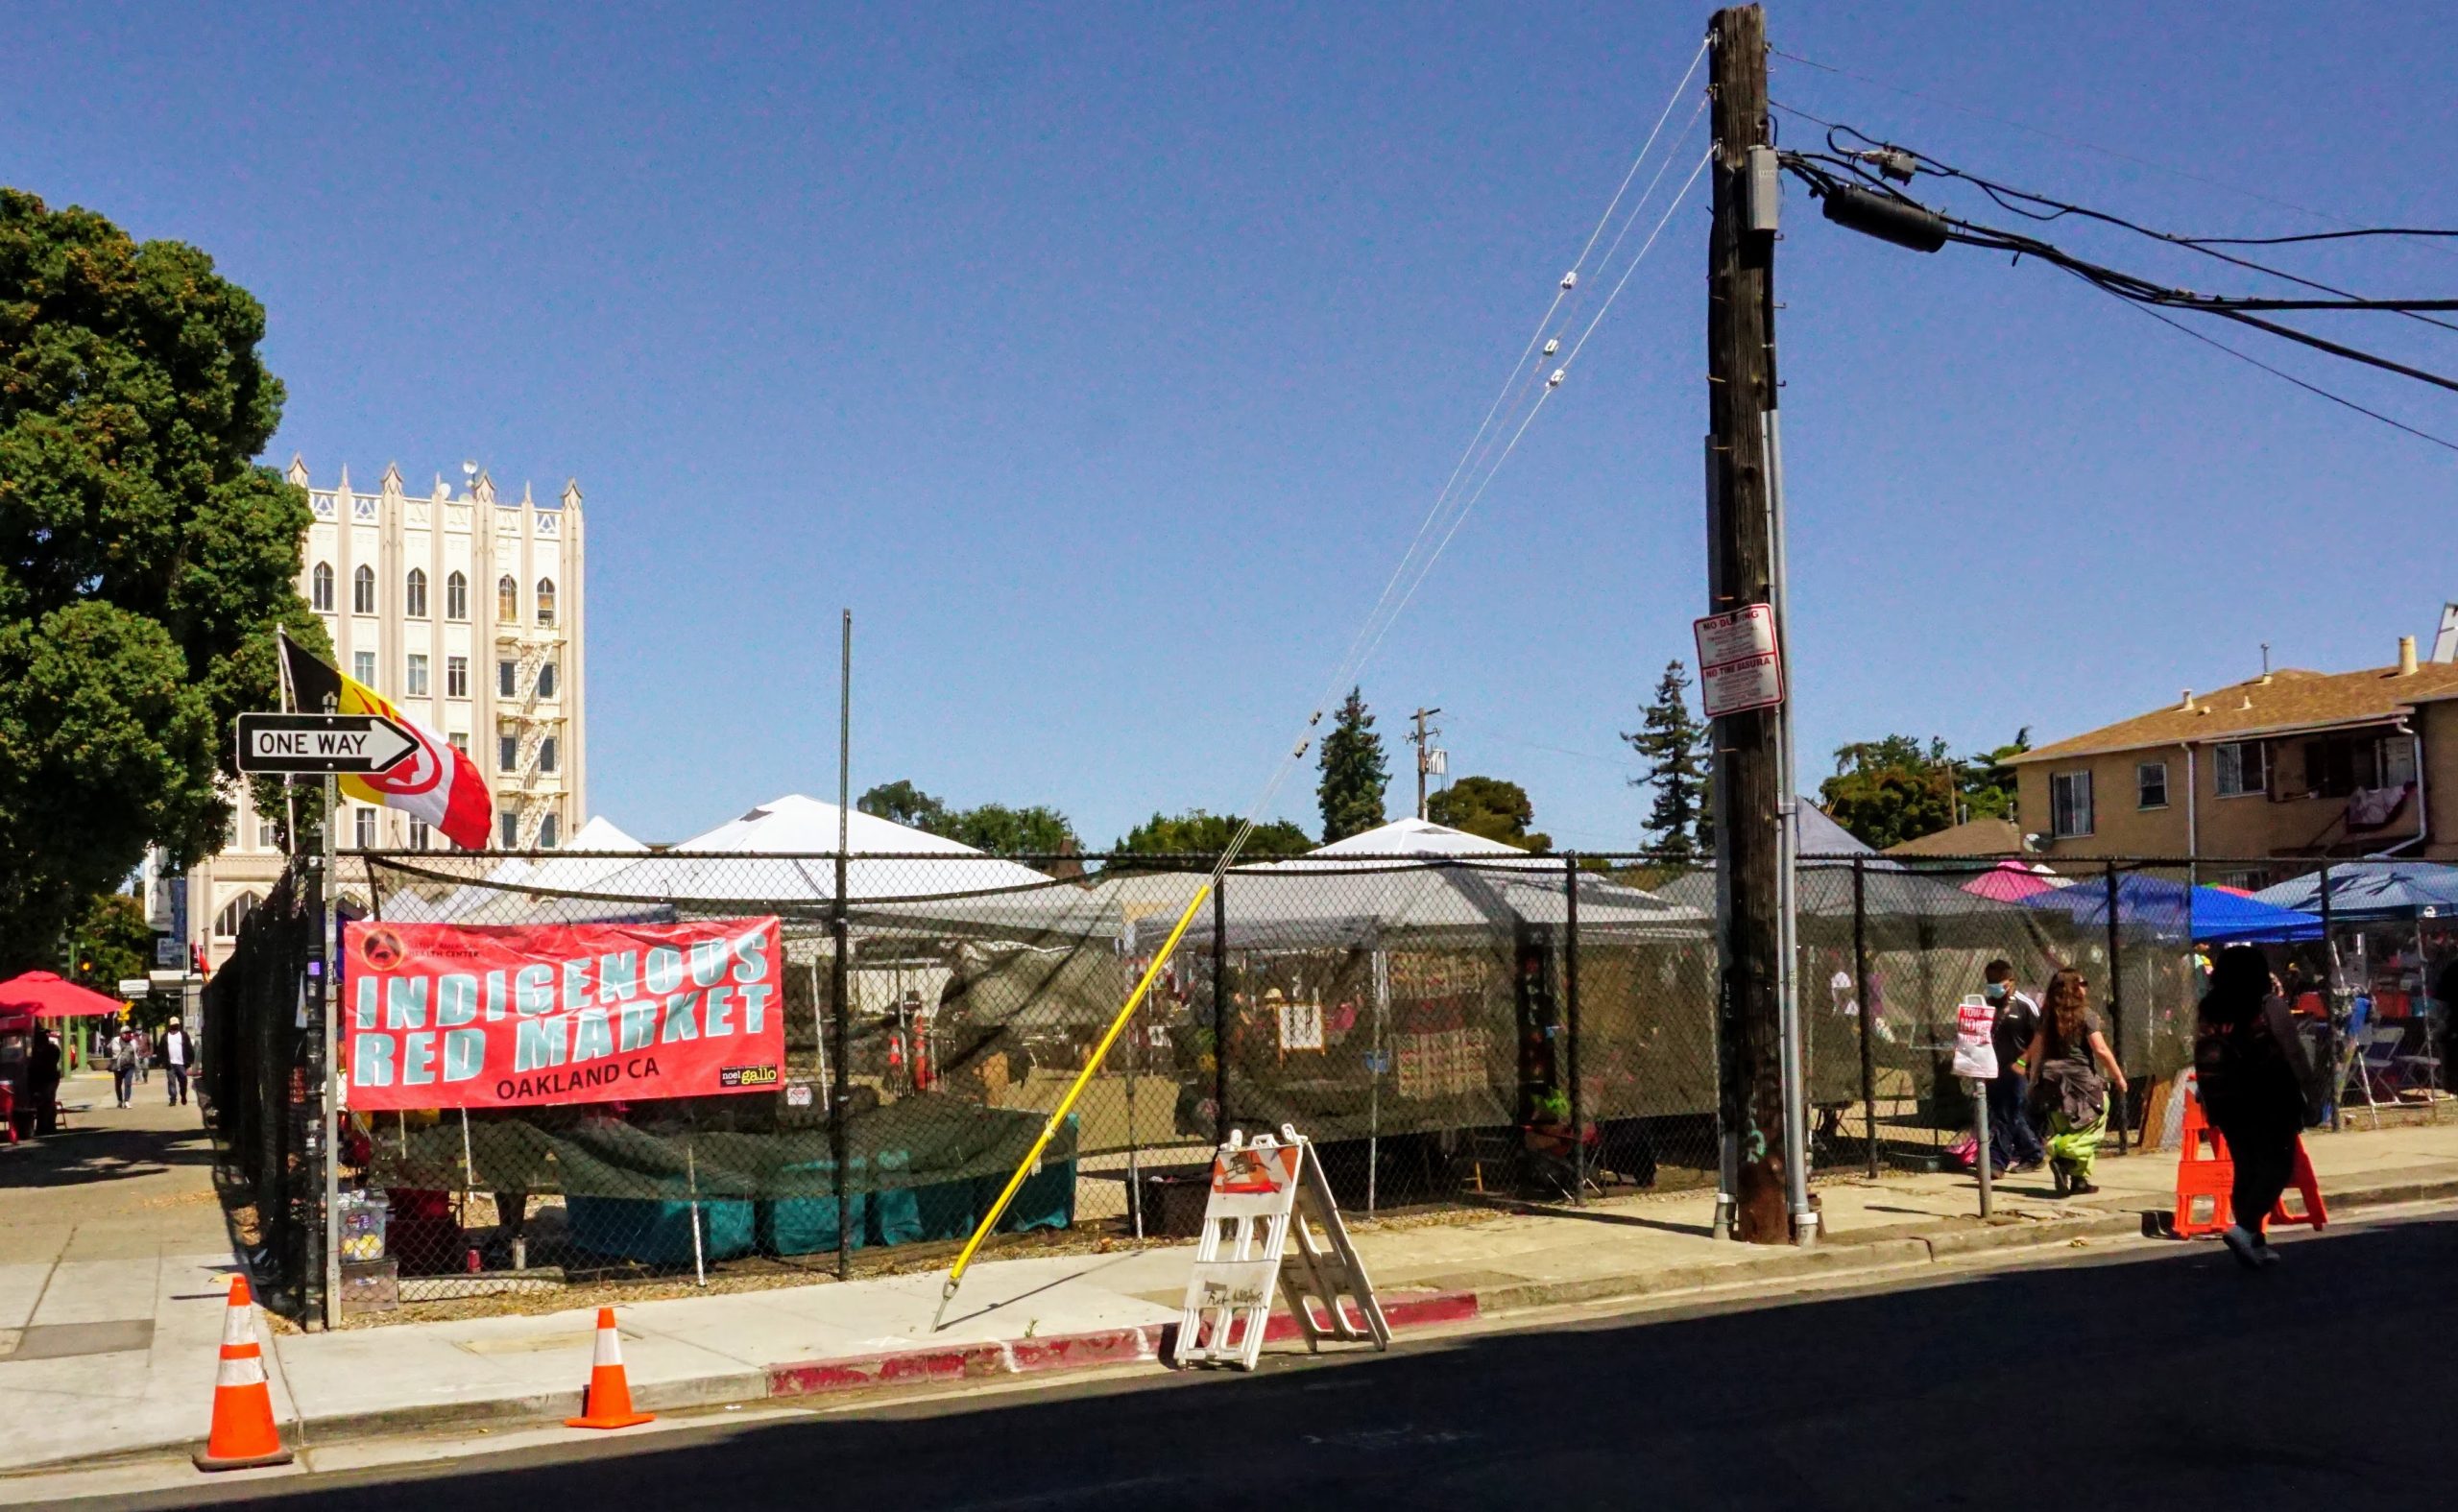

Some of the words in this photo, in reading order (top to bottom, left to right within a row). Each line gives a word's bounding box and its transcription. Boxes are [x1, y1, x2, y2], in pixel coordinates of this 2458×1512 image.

[1702, 622, 1717, 631] NO
[1705, 668, 1718, 679] NO
[1737, 657, 1771, 672] BASURA
[259, 732, 308, 755] ONE
[318, 733, 367, 756] WAY
[446, 949, 479, 958] CENTER
[356, 933, 767, 1030] INDIGENOUS
[354, 1028, 486, 1087] RED
[514, 984, 773, 1073] MARKET
[1960, 1018, 1976, 1032] NO
[496, 1063, 620, 1100] OAKLAND
[627, 1057, 660, 1078] CA
[722, 1070, 740, 1080] noel
[741, 1068, 777, 1085] gallo
